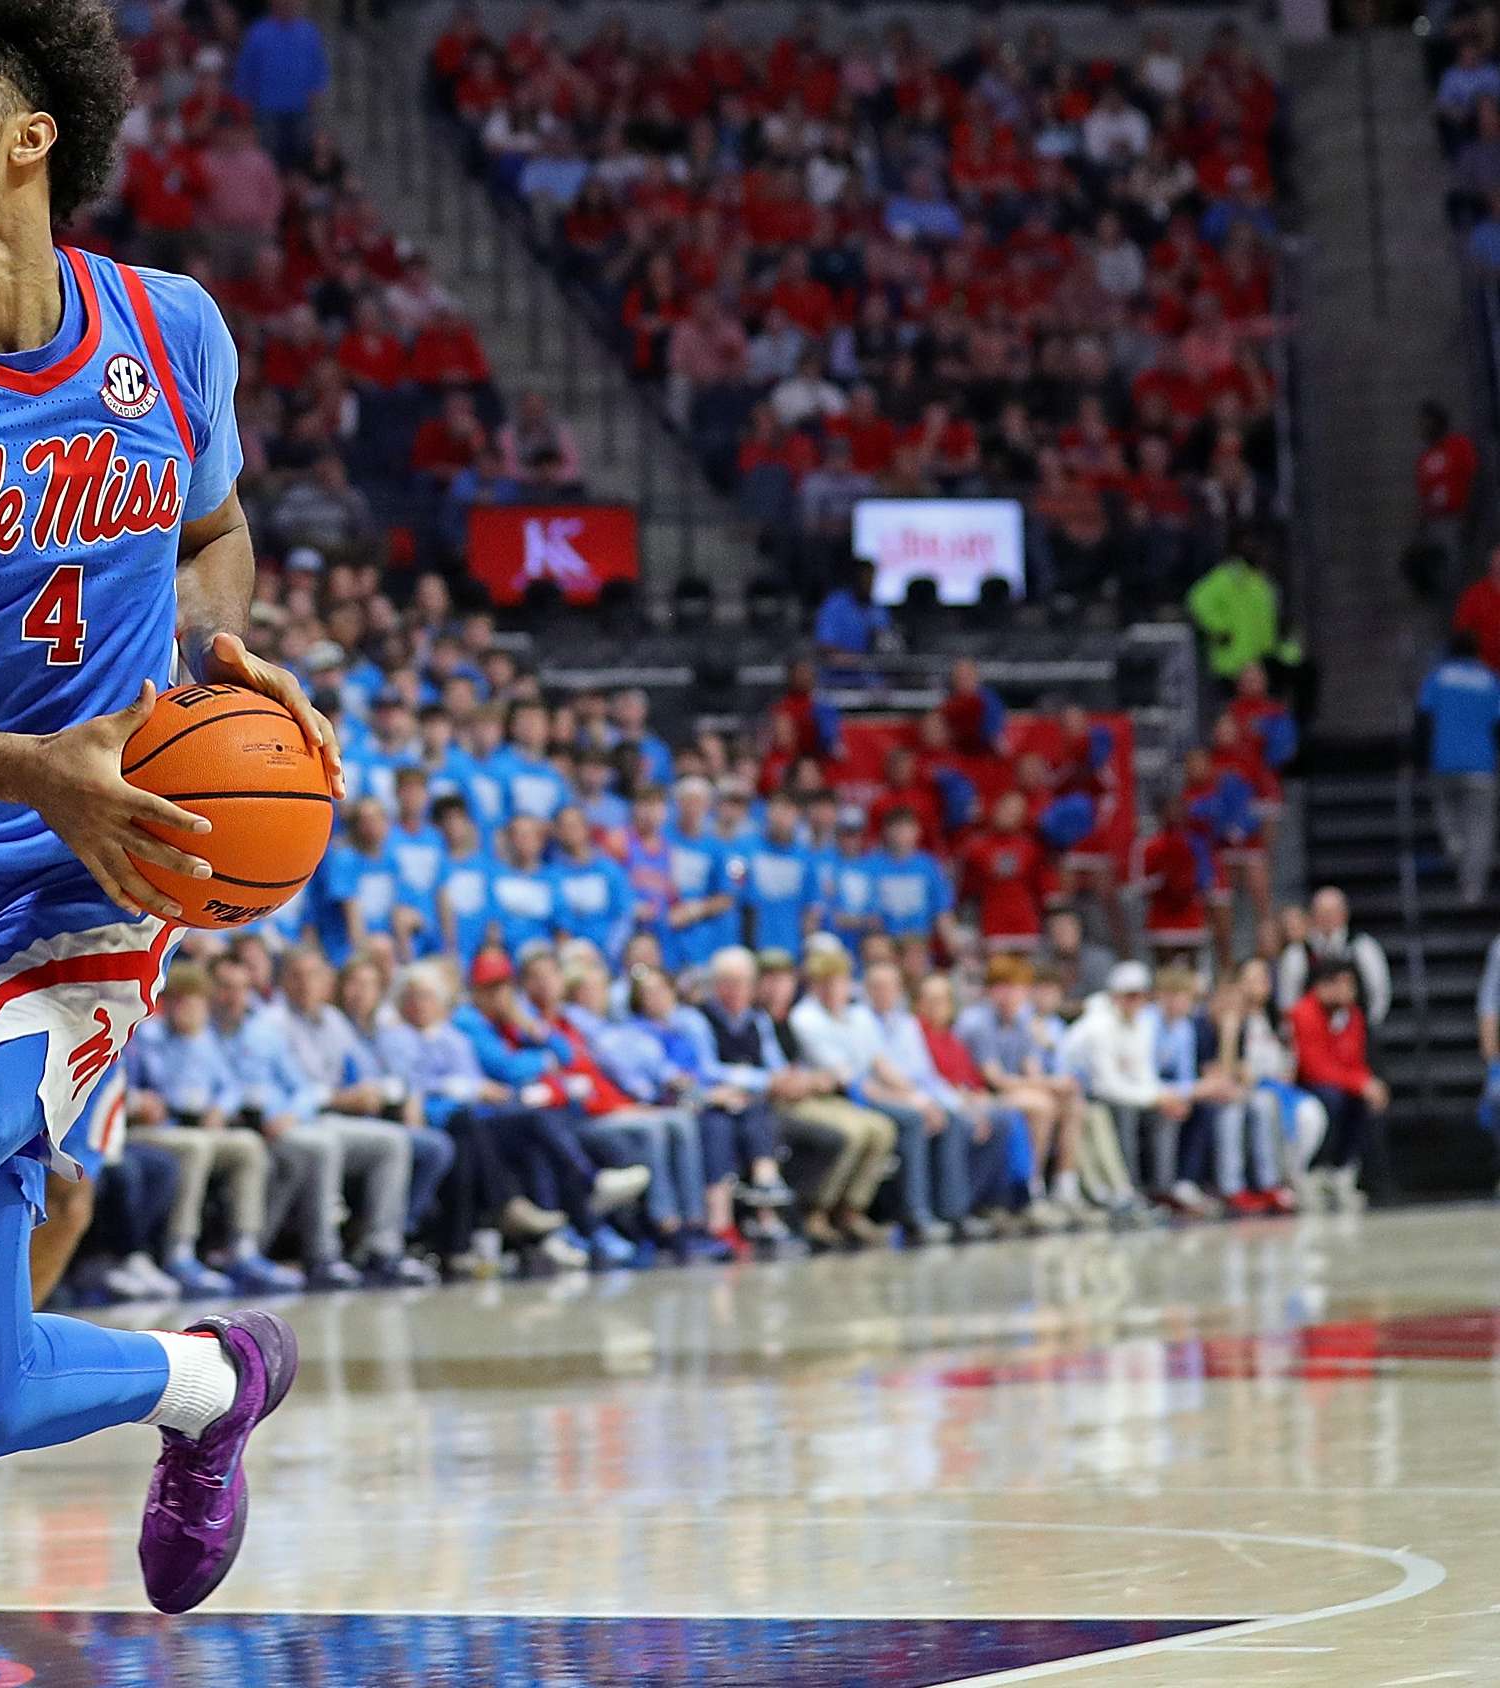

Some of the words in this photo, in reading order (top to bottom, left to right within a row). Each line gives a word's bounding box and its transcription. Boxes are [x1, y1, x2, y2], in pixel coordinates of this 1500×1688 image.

[107, 356, 145, 402] SEC
[107, 397, 153, 417] GRADUATE
[23, 428, 183, 550] Miss
[21, 565, 87, 667] 4
